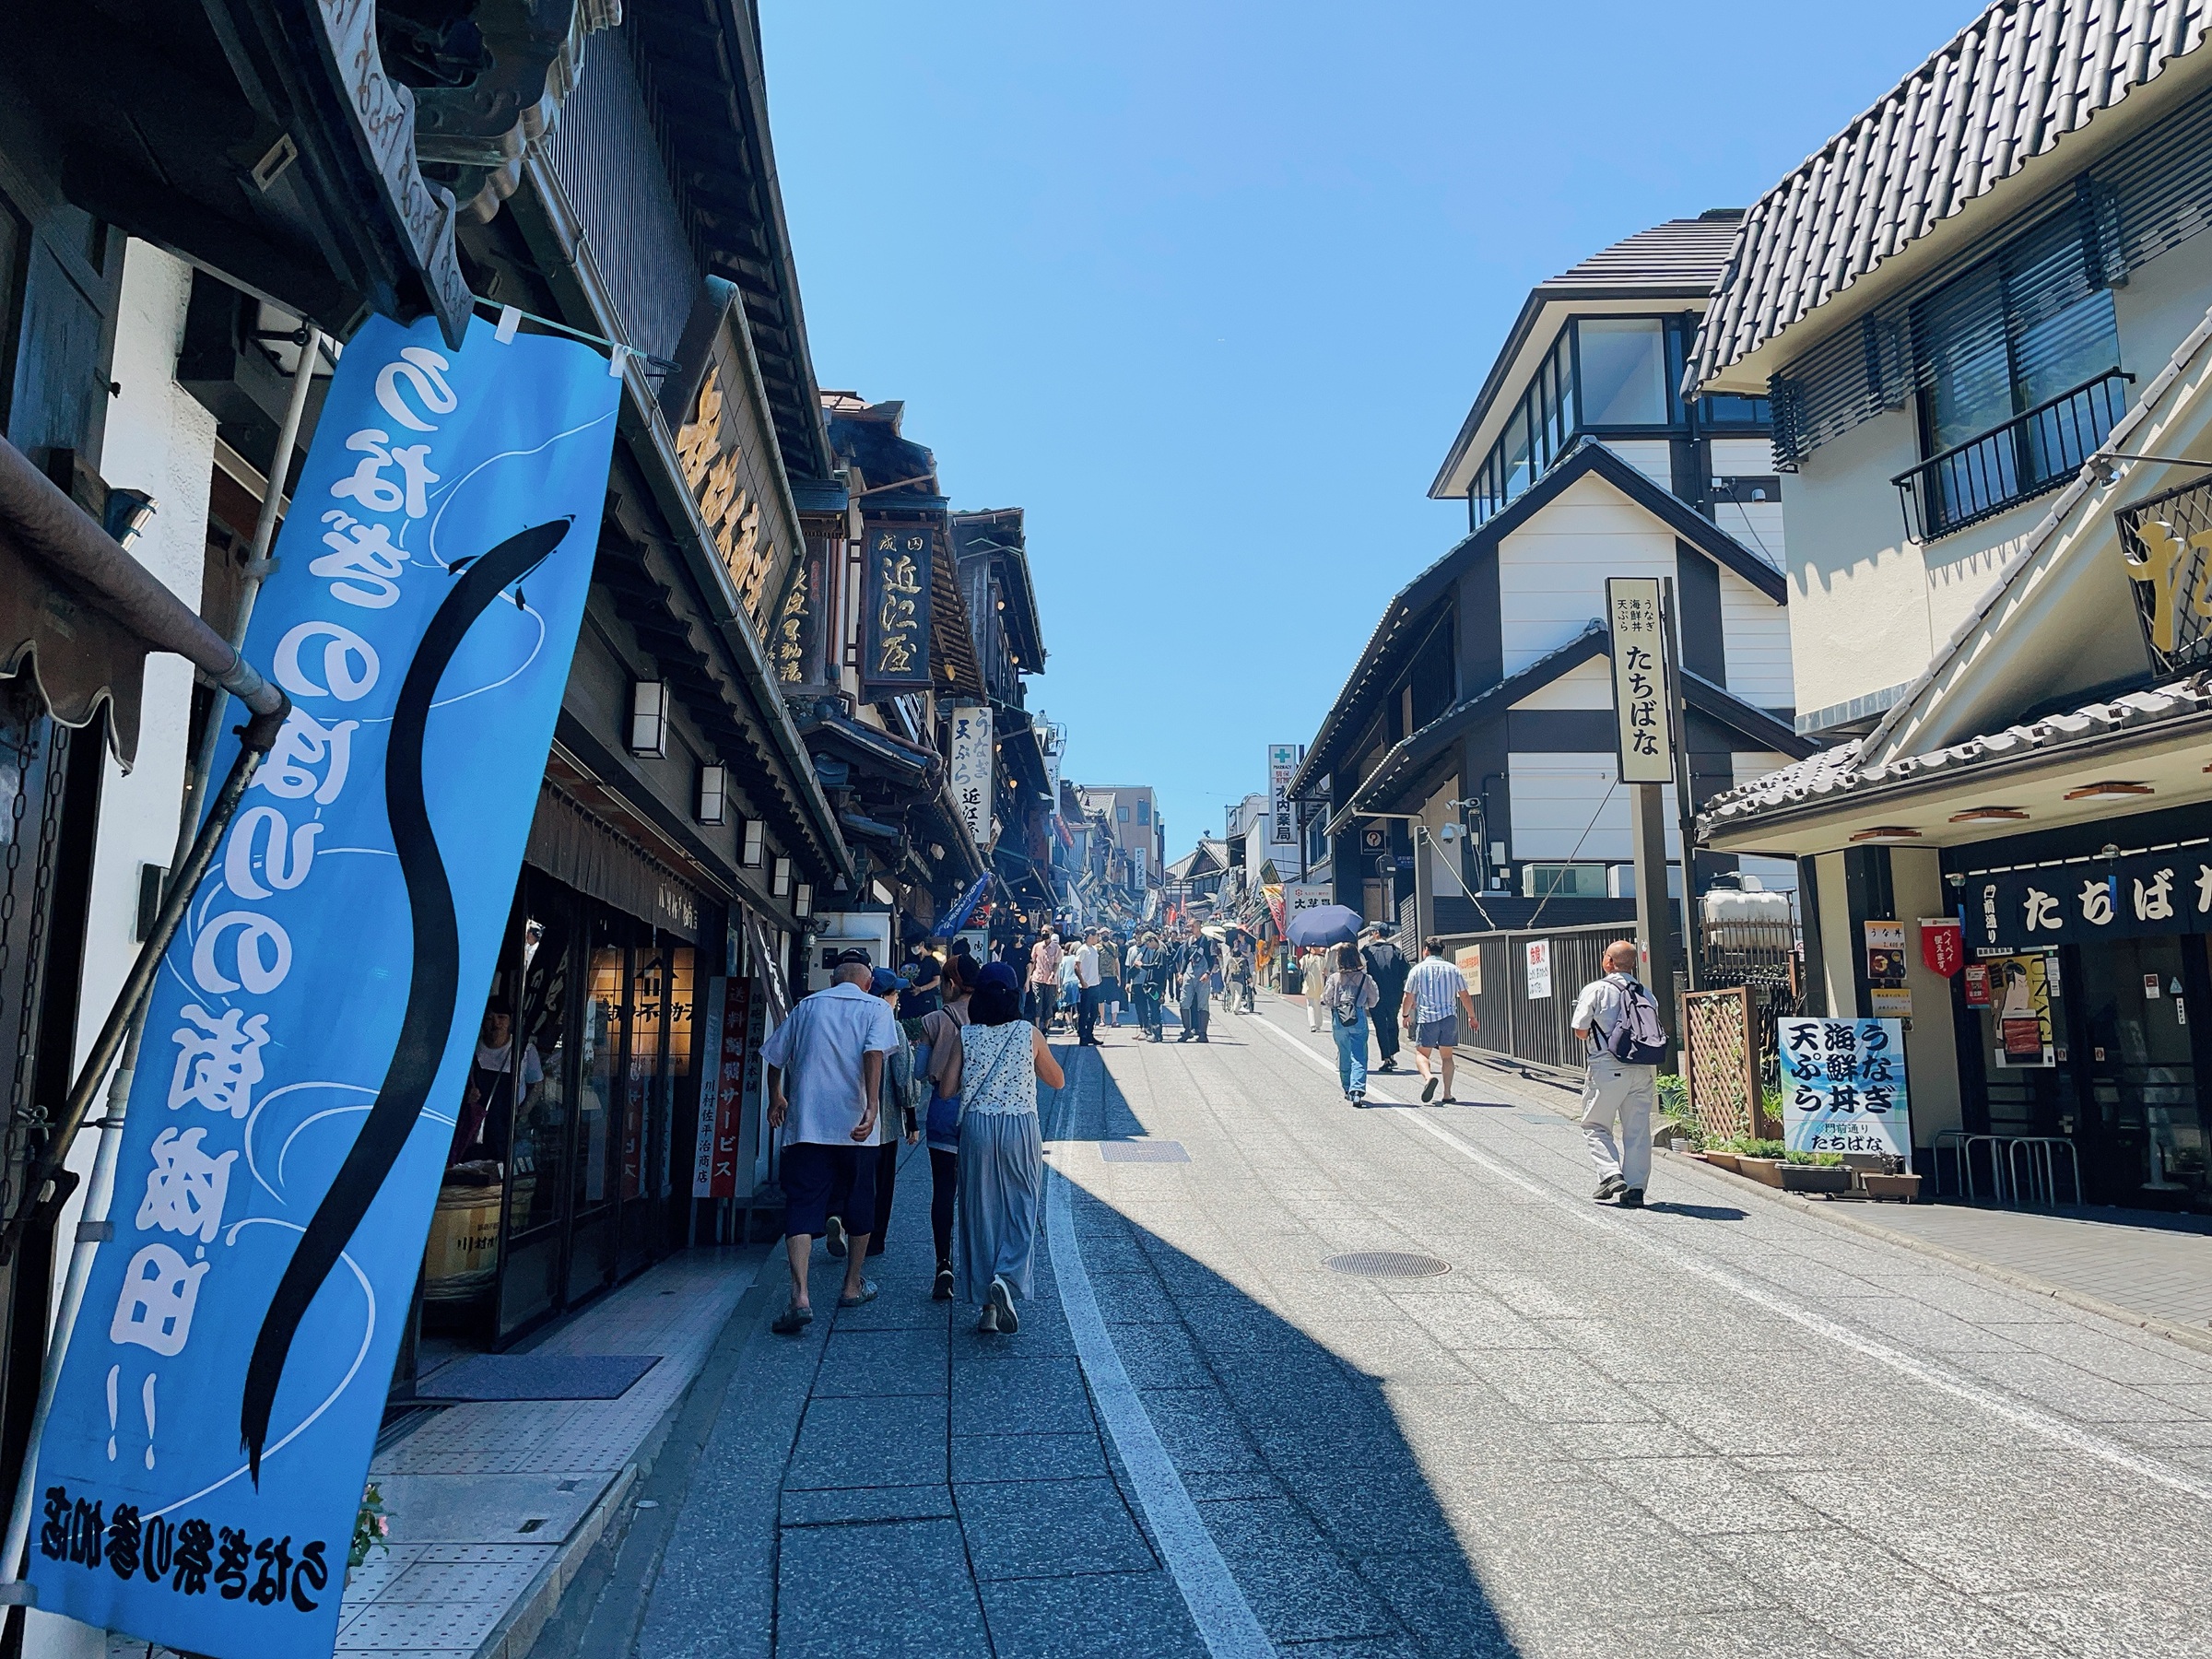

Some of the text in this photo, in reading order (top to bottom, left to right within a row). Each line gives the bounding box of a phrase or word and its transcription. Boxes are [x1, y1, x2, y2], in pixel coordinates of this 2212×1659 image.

[878, 555, 923, 673] 近江屋
[1617, 599, 1629, 631] 天ぷら
[1630, 599, 1642, 632] 海鮮丼
[1644, 599, 1655, 632] うなぎ
[1626, 645, 1659, 756] たちばな
[954, 719, 971, 784] 天ぷら
[972, 709, 992, 779] うなぎ
[1943, 929, 1954, 962] ペイペイ
[1788, 1023, 1822, 1112] 天ぷら
[1823, 1023, 1860, 1113] 海鮮丼
[1861, 1024, 1896, 1113] うなぎ
[697, 1079, 716, 1183] 川村佐平治商店
[1811, 1135, 1883, 1152] たちばな
[1825, 1124, 1869, 1135] 門前通り
